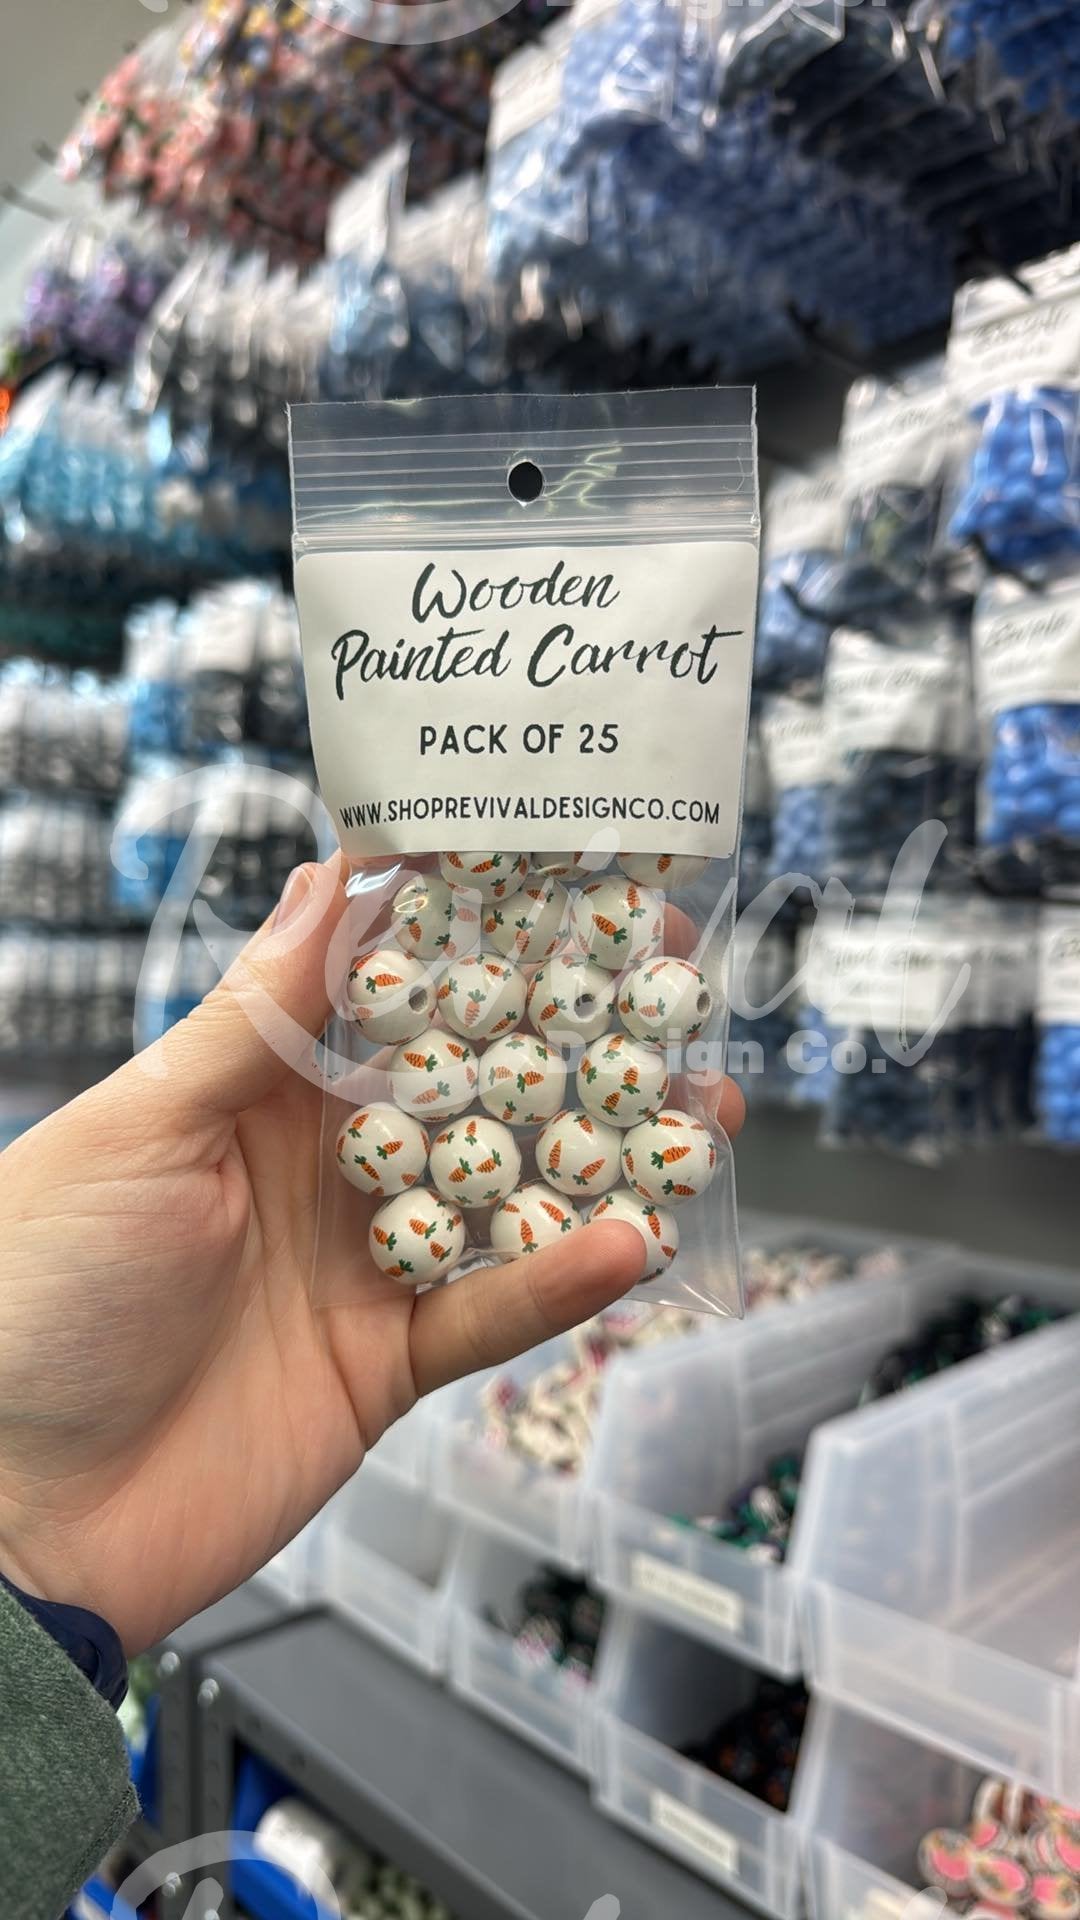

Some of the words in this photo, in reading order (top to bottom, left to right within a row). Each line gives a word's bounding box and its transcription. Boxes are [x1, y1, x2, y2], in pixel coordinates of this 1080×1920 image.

[412, 561, 620, 623] Wooden
[331, 626, 512, 701] Painted
[528, 623, 745, 688] Carrot
[420, 724, 507, 756] PACK
[523, 723, 564, 754] OF
[579, 723, 619, 754] 25
[339, 796, 720, 829] WWW.SHOPREVIVALDESIGNCO.COM
